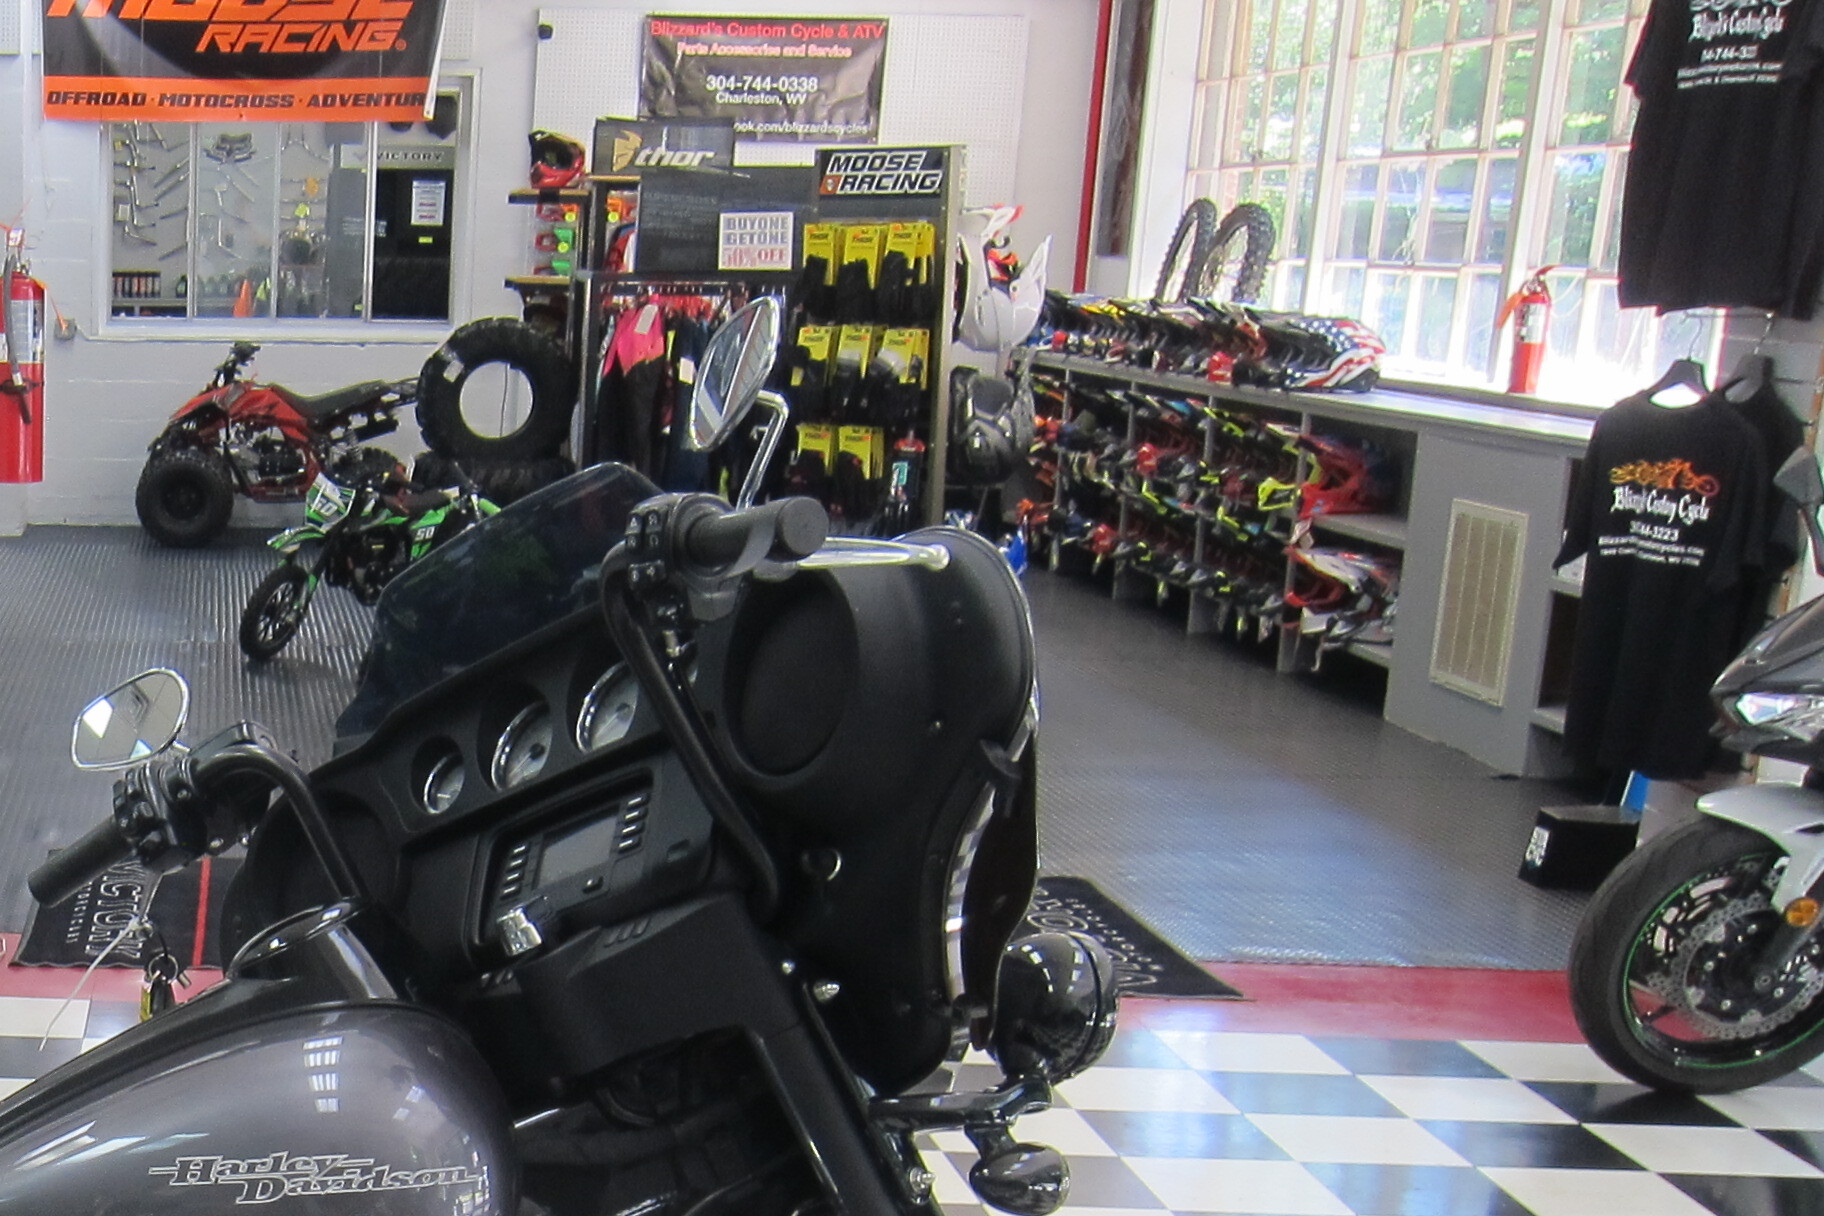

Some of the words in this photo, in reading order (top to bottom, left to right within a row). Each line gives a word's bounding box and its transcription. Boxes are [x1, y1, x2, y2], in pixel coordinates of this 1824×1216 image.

[195, 21, 403, 53] RACING
[651, 21, 723, 38] Blizzard's
[726, 22, 786, 38] Custom
[791, 23, 835, 41] Cycle
[837, 24, 850, 39] &
[853, 24, 885, 39] ATV
[783, 44, 806, 57] and
[706, 74, 818, 92] 304-744-0338
[47, 91, 146, 107] OFFROAD
[157, 92, 294, 108] MOTOCROSS
[716, 91, 783, 106] Charleston,
[786, 93, 807, 105] WV
[376, 151, 443, 162] VICTORY
[826, 151, 928, 175] MOOSE
[837, 171, 943, 195] RACING
[416, 526, 436, 541] 50
[149, 1151, 374, 1187] Harley
[220, 1164, 480, 1205] Davidson
